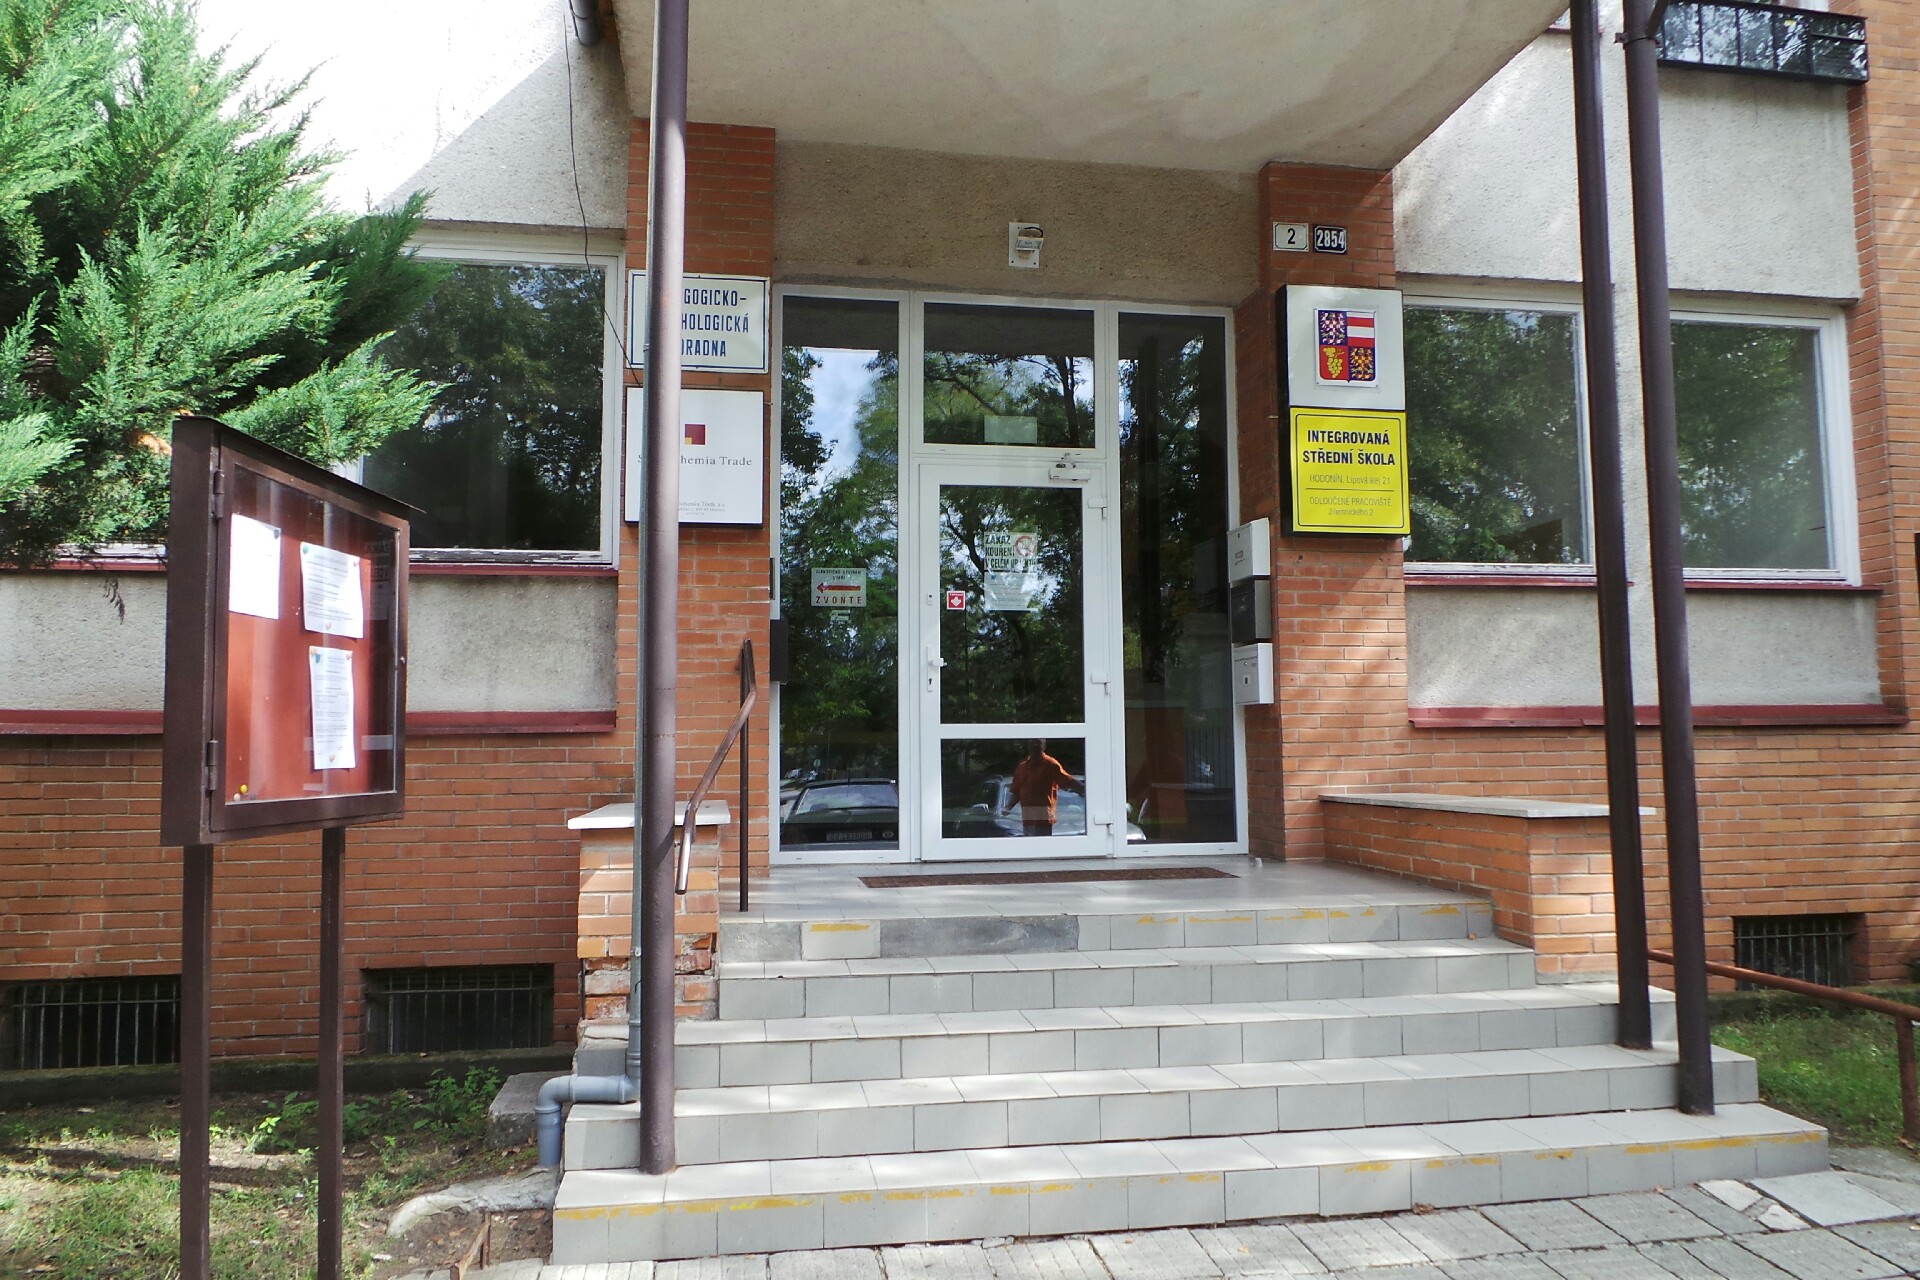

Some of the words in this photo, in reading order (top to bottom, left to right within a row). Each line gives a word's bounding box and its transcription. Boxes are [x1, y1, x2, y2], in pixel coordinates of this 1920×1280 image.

[1287, 228, 1296, 245] 2
[1316, 229, 1345, 249] 2854
[684, 288, 747, 306] GOGICKO-
[681, 312, 749, 333] HOLOGICKÁ
[681, 338, 726, 357] RADNA
[1307, 429, 1390, 445] INTEGROVANÁ
[680, 455, 716, 465] hemia
[718, 456, 753, 466] Trade
[1302, 447, 1353, 464] STŘEDNÍ
[1357, 448, 1396, 466] ŠKOLA
[1382, 477, 1391, 485] 21
